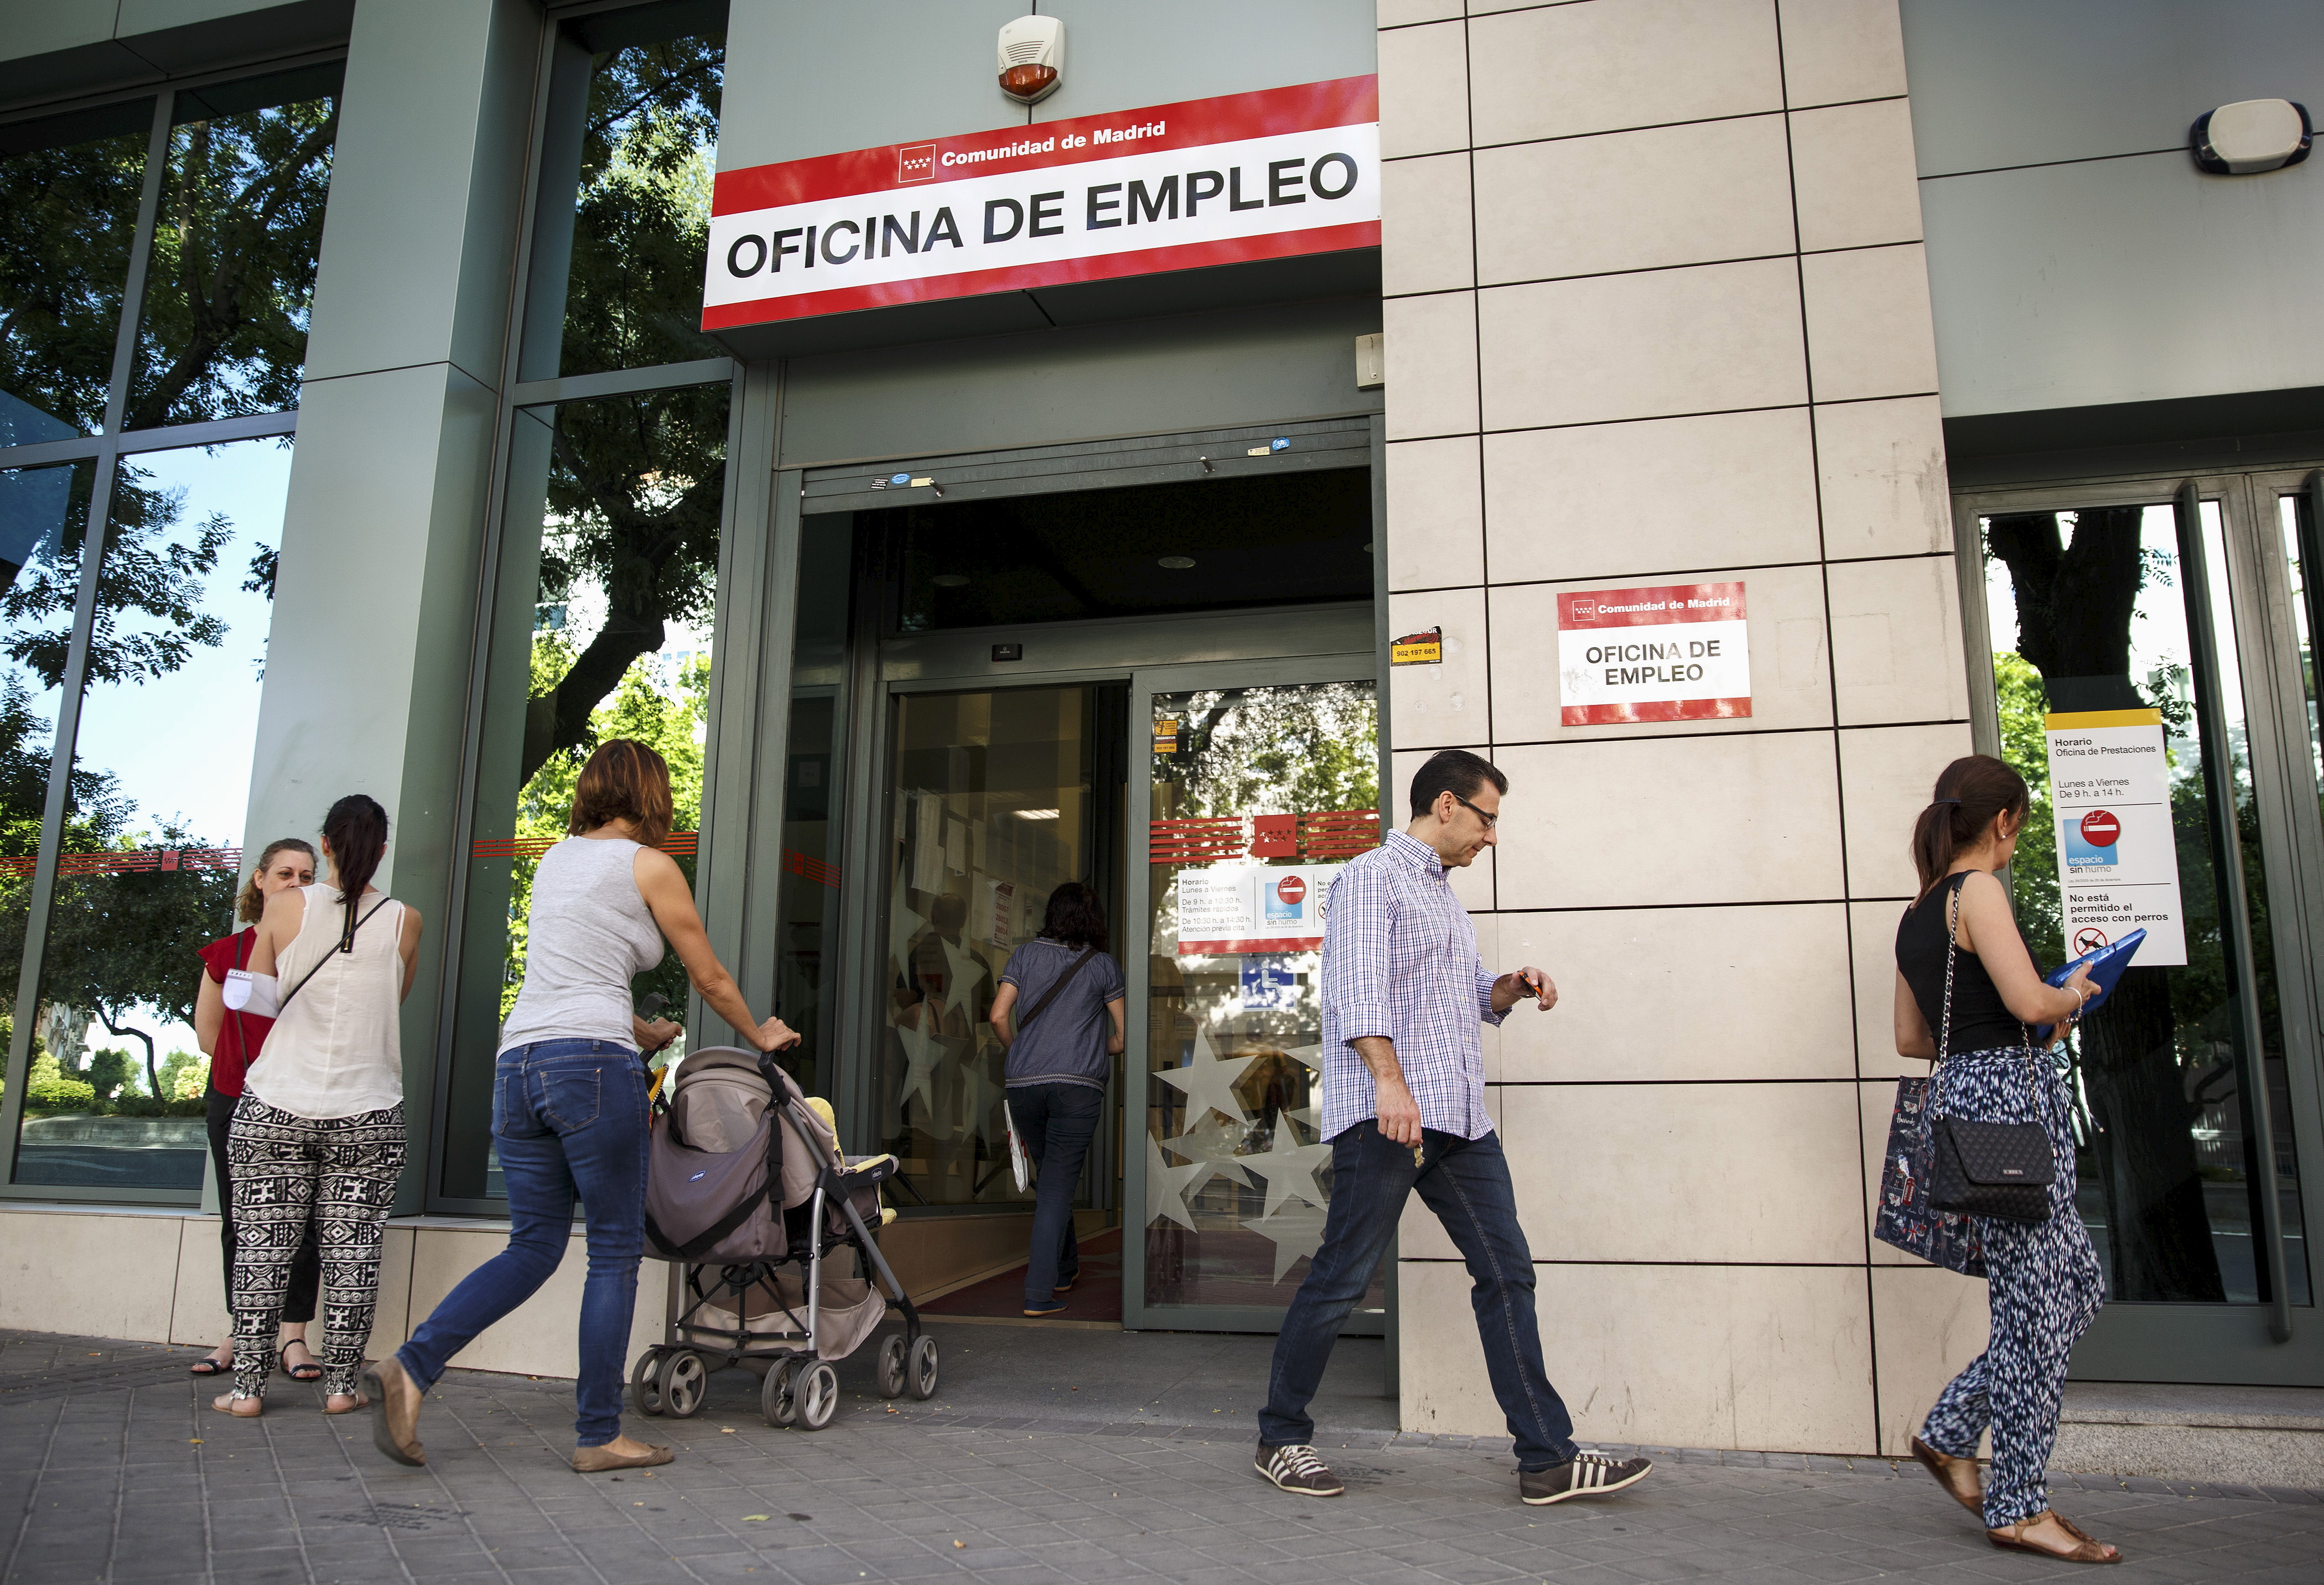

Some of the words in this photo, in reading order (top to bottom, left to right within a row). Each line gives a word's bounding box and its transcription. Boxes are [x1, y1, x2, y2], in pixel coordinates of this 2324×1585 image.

[941, 136, 1055, 168] Comunidad
[1061, 132, 1086, 150] de
[1093, 120, 1166, 144] Madrid
[727, 206, 963, 279] OFICINA
[983, 190, 1065, 244] DE
[1086, 152, 1358, 230] EMPLEO
[1598, 602, 1666, 614] Comunidad
[1669, 600, 1684, 610] de
[1688, 596, 1730, 609] Madrid
[1586, 642, 1683, 664] OFICINA
[1689, 640, 1721, 658] DE
[1605, 664, 1703, 686] EMPLEO
[2055, 738, 2092, 746] Horario
[2056, 749, 2086, 757] Oficina
[2101, 745, 2156, 755] Prestaciones
[2058, 779, 2086, 788] Lunes
[2096, 777, 2129, 787] Viernes
[2060, 789, 2072, 798] De
[2074, 789, 2081, 798] 9
[2083, 788, 2092, 797] h.
[2069, 855, 2103, 865] espacio
[2069, 865, 2083, 874] sin
[2085, 865, 2112, 873] humo
[2088, 893, 2109, 902] está
[1213, 905, 1238, 913] rápidos
[2071, 903, 2120, 914] permitido
[2123, 903, 2132, 912] el
[2071, 914, 2109, 923] acceso
[2134, 913, 2169, 923] perros
[1182, 924, 1210, 933] Atención
[1896, 1113, 1915, 1126] Harrods
[1881, 1204, 1897, 1219] Harrods
